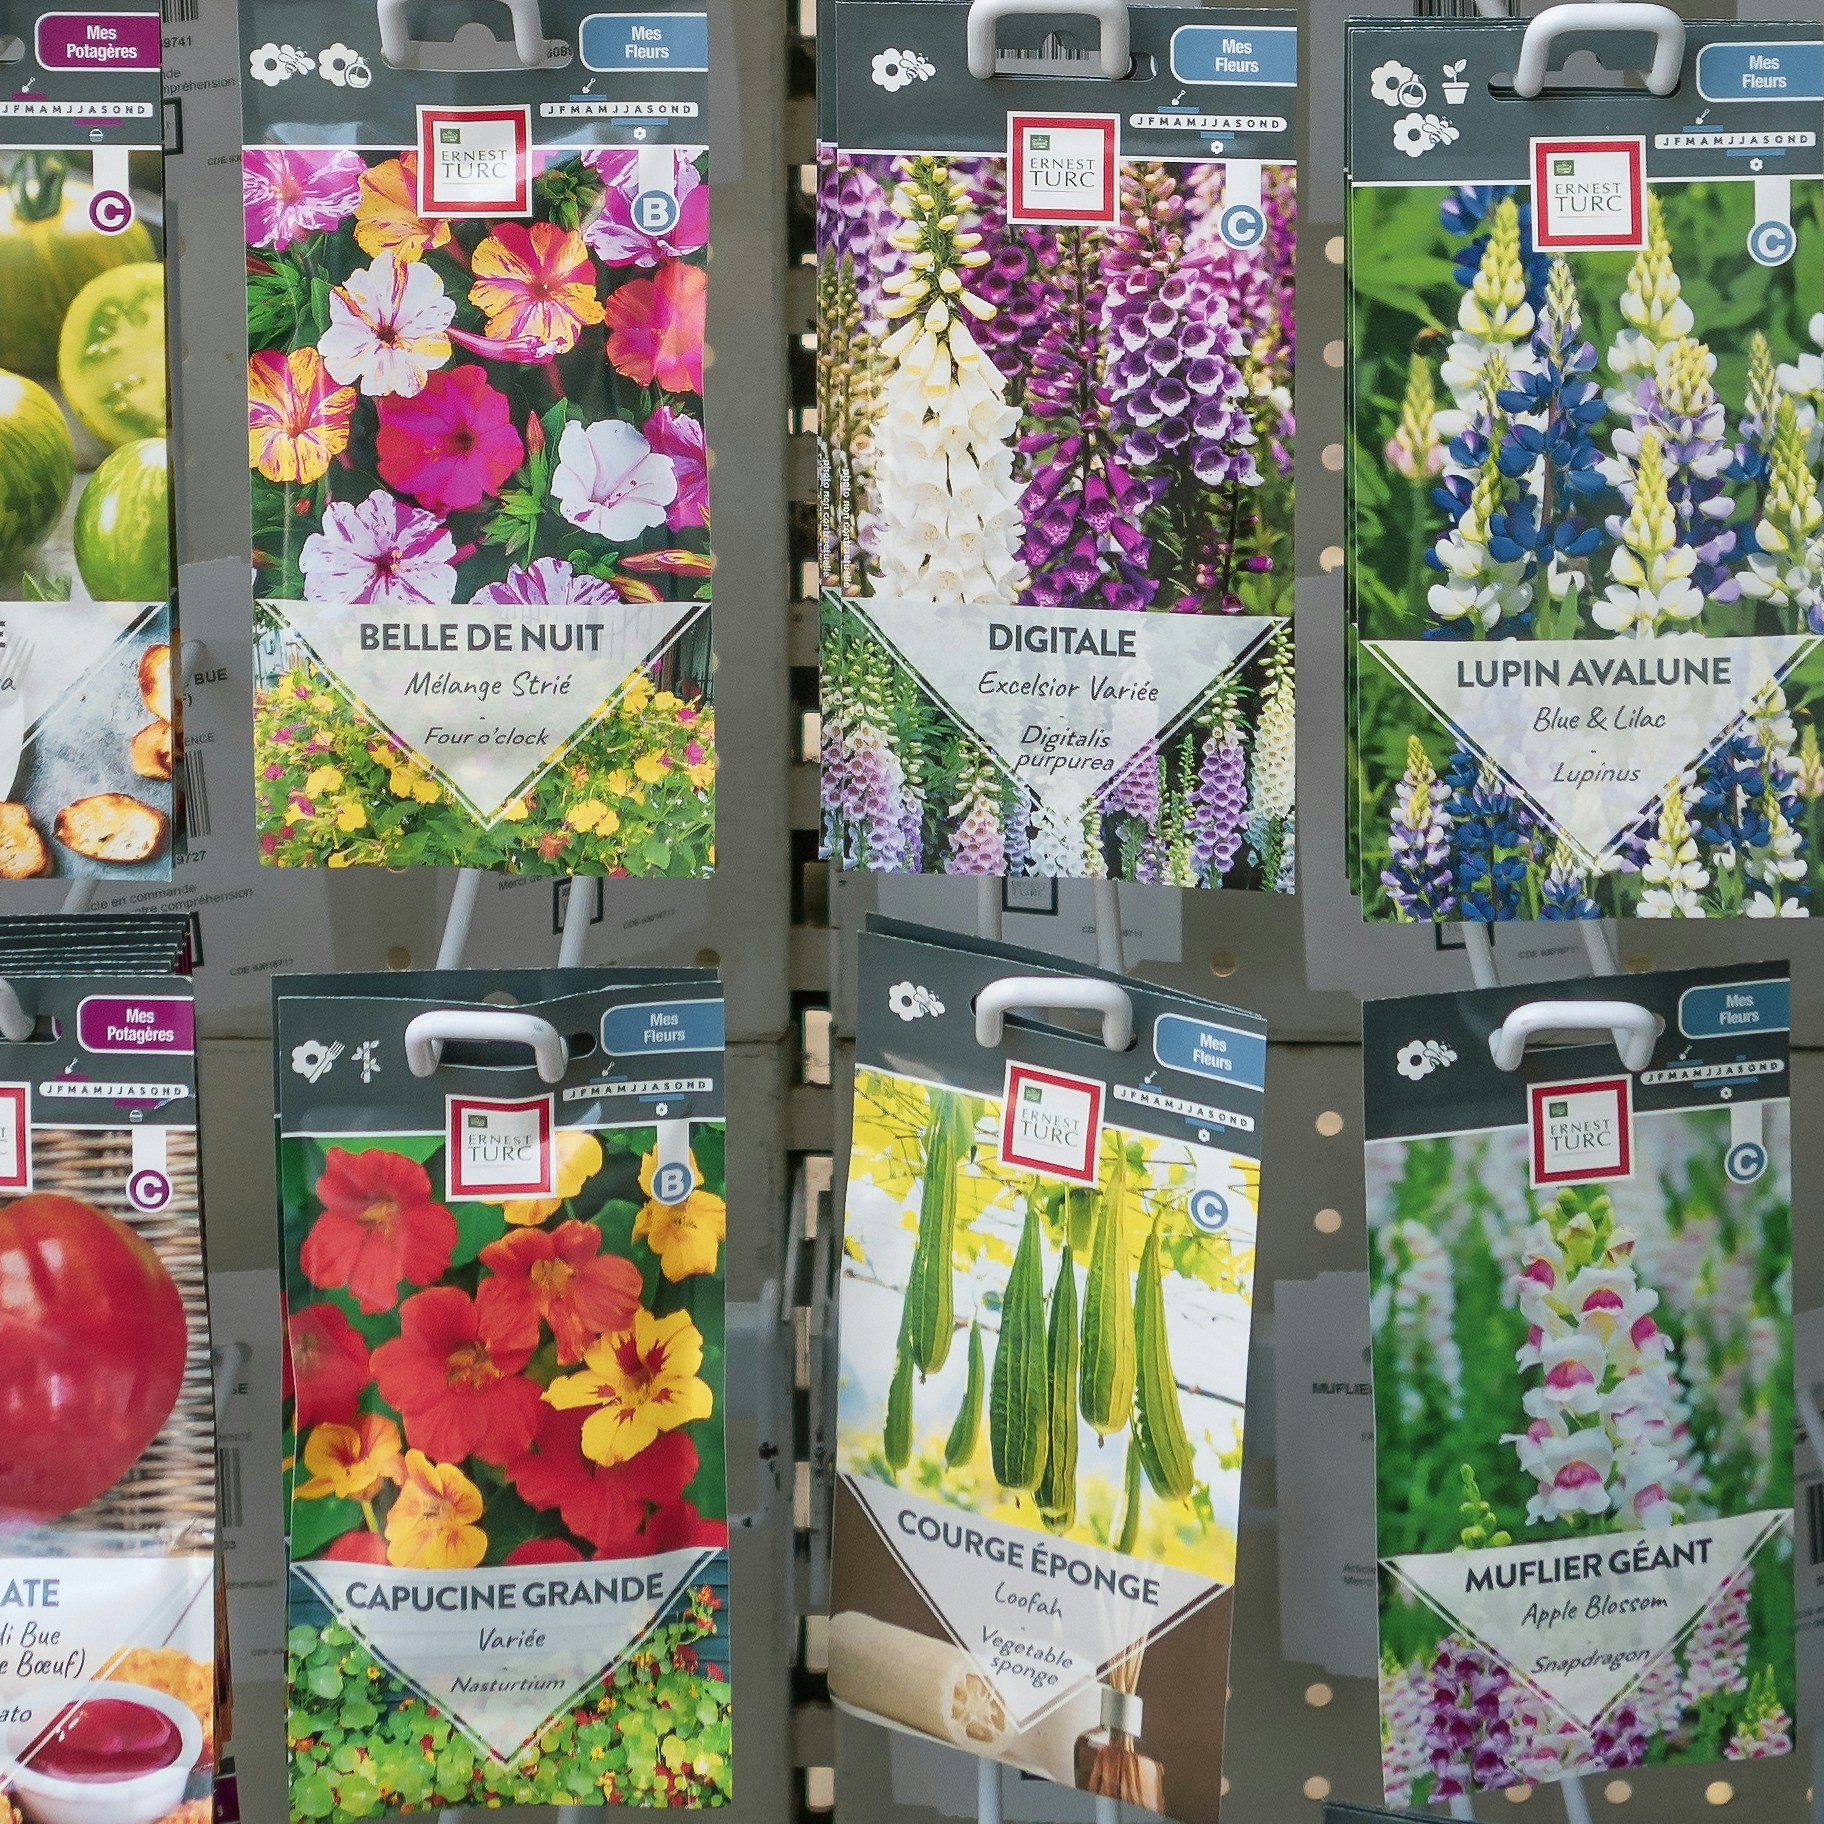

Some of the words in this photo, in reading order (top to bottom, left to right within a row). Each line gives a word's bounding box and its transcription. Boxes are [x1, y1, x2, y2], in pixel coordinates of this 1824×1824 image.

[632, 26, 662, 42] Mes
[624, 44, 669, 62] Fleurs
[441, 161, 507, 178] TURC
[442, 150, 507, 164] ERNEST
[360, 624, 456, 651] BELLE
[467, 624, 513, 652] DE
[522, 625, 603, 652] NUIT
[988, 624, 1136, 658] DIGITALE
[1457, 659, 1559, 689] LUPIN
[1567, 656, 1731, 686] AVALUNE
[425, 725, 474, 746] Four
[480, 727, 548, 747] o'clock
[1020, 727, 1110, 752] Digitalis
[1016, 752, 1114, 774] purpurea
[1553, 762, 1640, 789] Lupinus
[898, 1510, 1024, 1572] COURGE
[1030, 1540, 1159, 1607] ÉPONGE
[1464, 1553, 1604, 1593] MUFLIER
[1610, 1538, 1713, 1575] GÉANT
[346, 1583, 515, 1612] CAPUCINE
[522, 1573, 664, 1608] GRANDE
[994, 1581, 1064, 1620] Loofah
[1522, 1600, 1578, 1630] Apple
[1584, 1594, 1668, 1619] Blossom
[25, 1625, 60, 1646] Bue
[450, 1676, 566, 1694] Nasturtium
